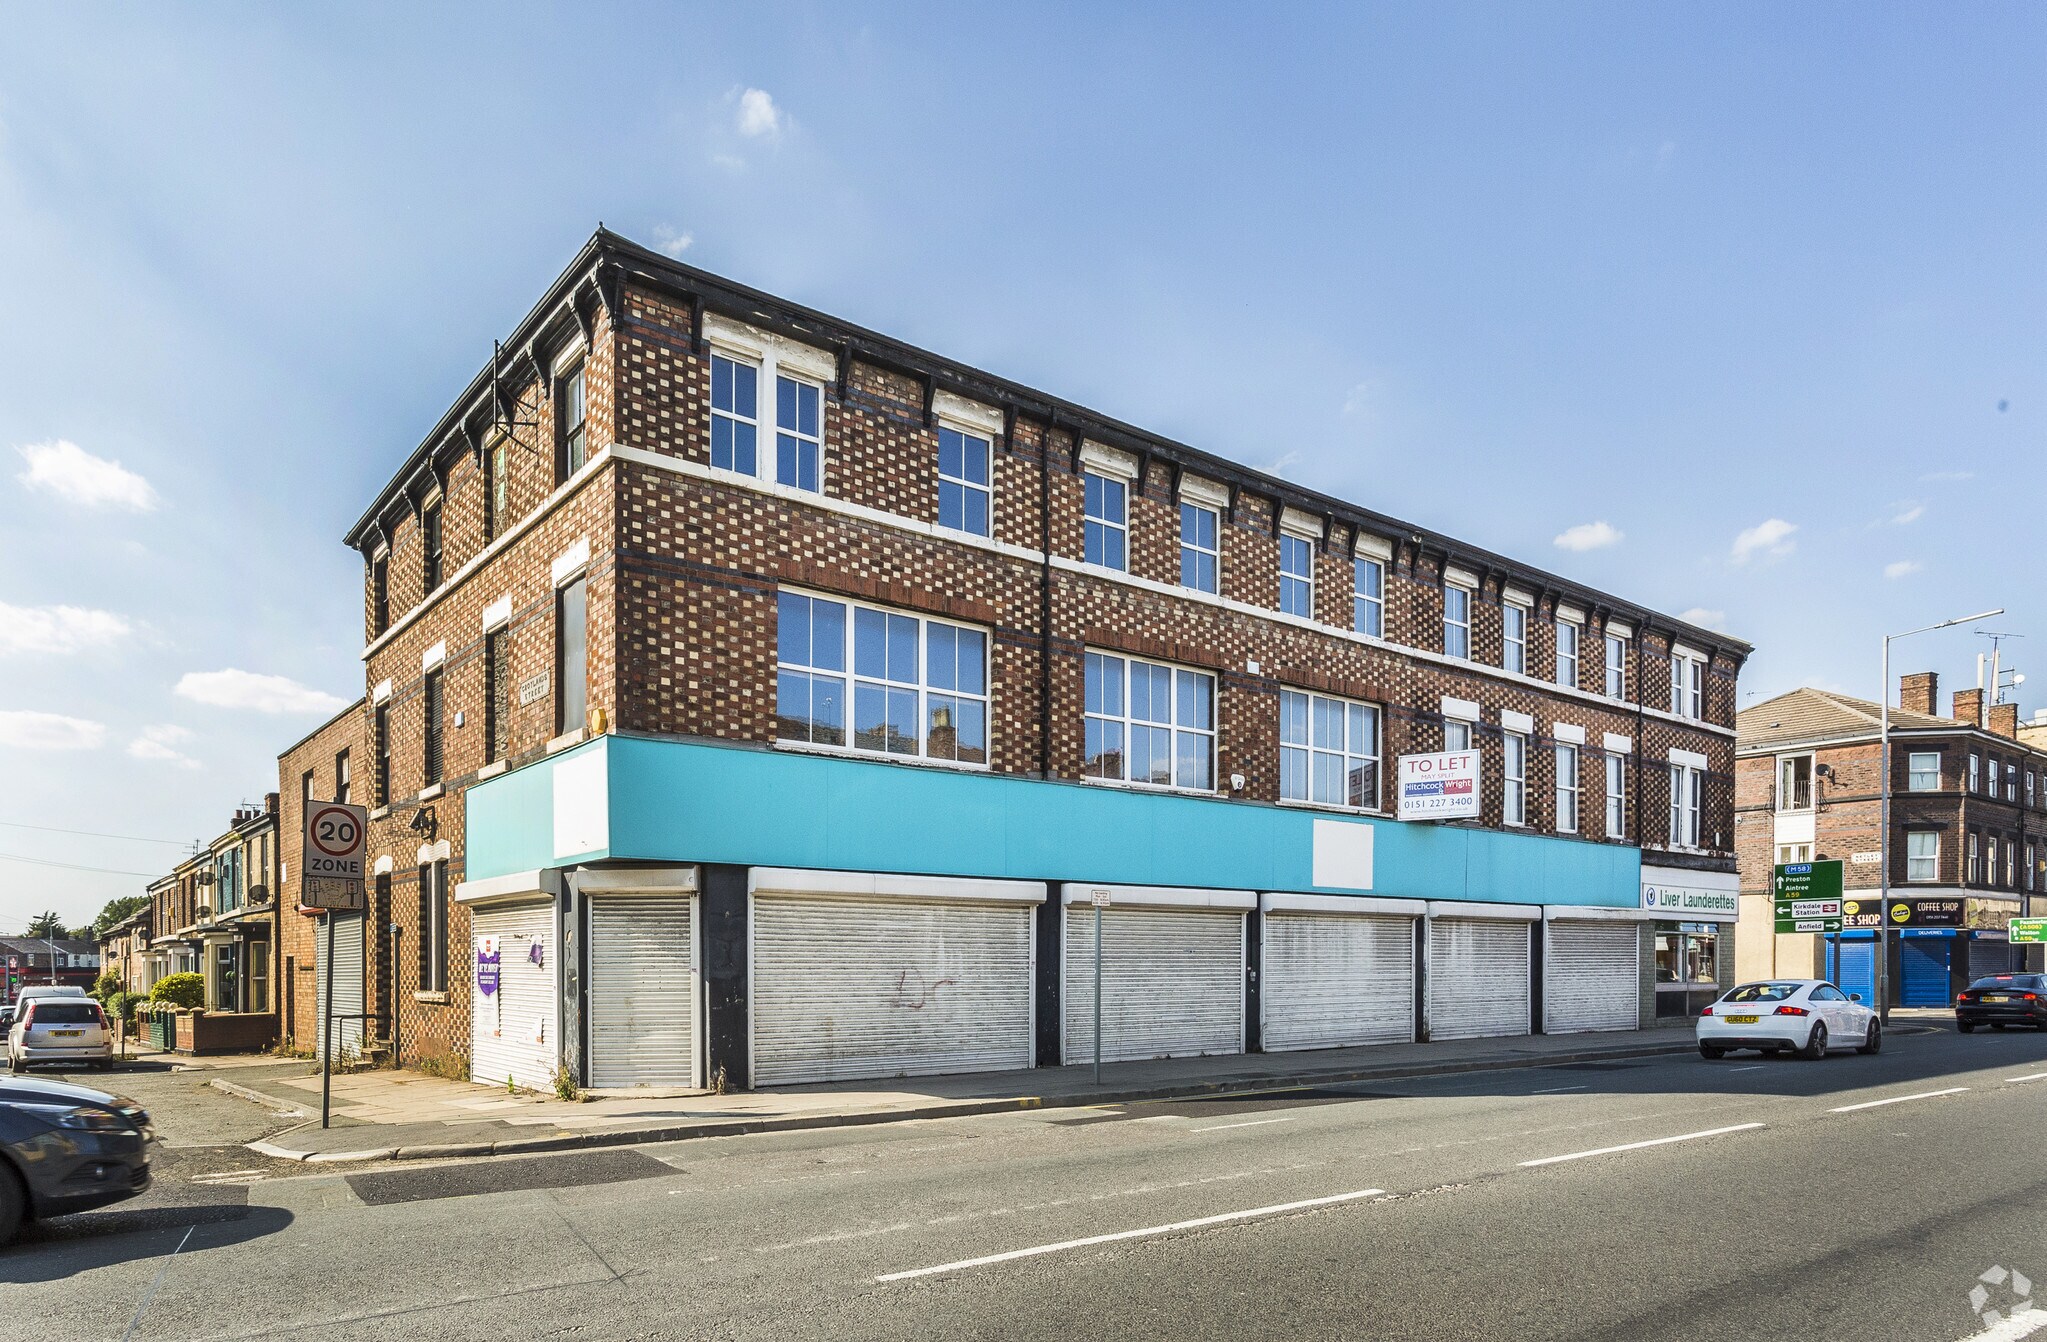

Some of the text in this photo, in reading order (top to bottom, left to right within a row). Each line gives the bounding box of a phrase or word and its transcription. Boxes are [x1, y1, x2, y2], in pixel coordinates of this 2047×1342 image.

[525, 685, 544, 700] STREET
[1408, 756, 1470, 773] TO LET
[1405, 780, 1471, 791] Hitchcock Wright
[1404, 797, 1473, 809] 0151 227 3400
[320, 821, 355, 843] 20
[311, 858, 359, 873] ZONE
[1660, 889, 1735, 910] Liver Launderettes
[1917, 902, 1959, 912] COFFEE SHOP
[1857, 914, 1881, 925] SHOP
